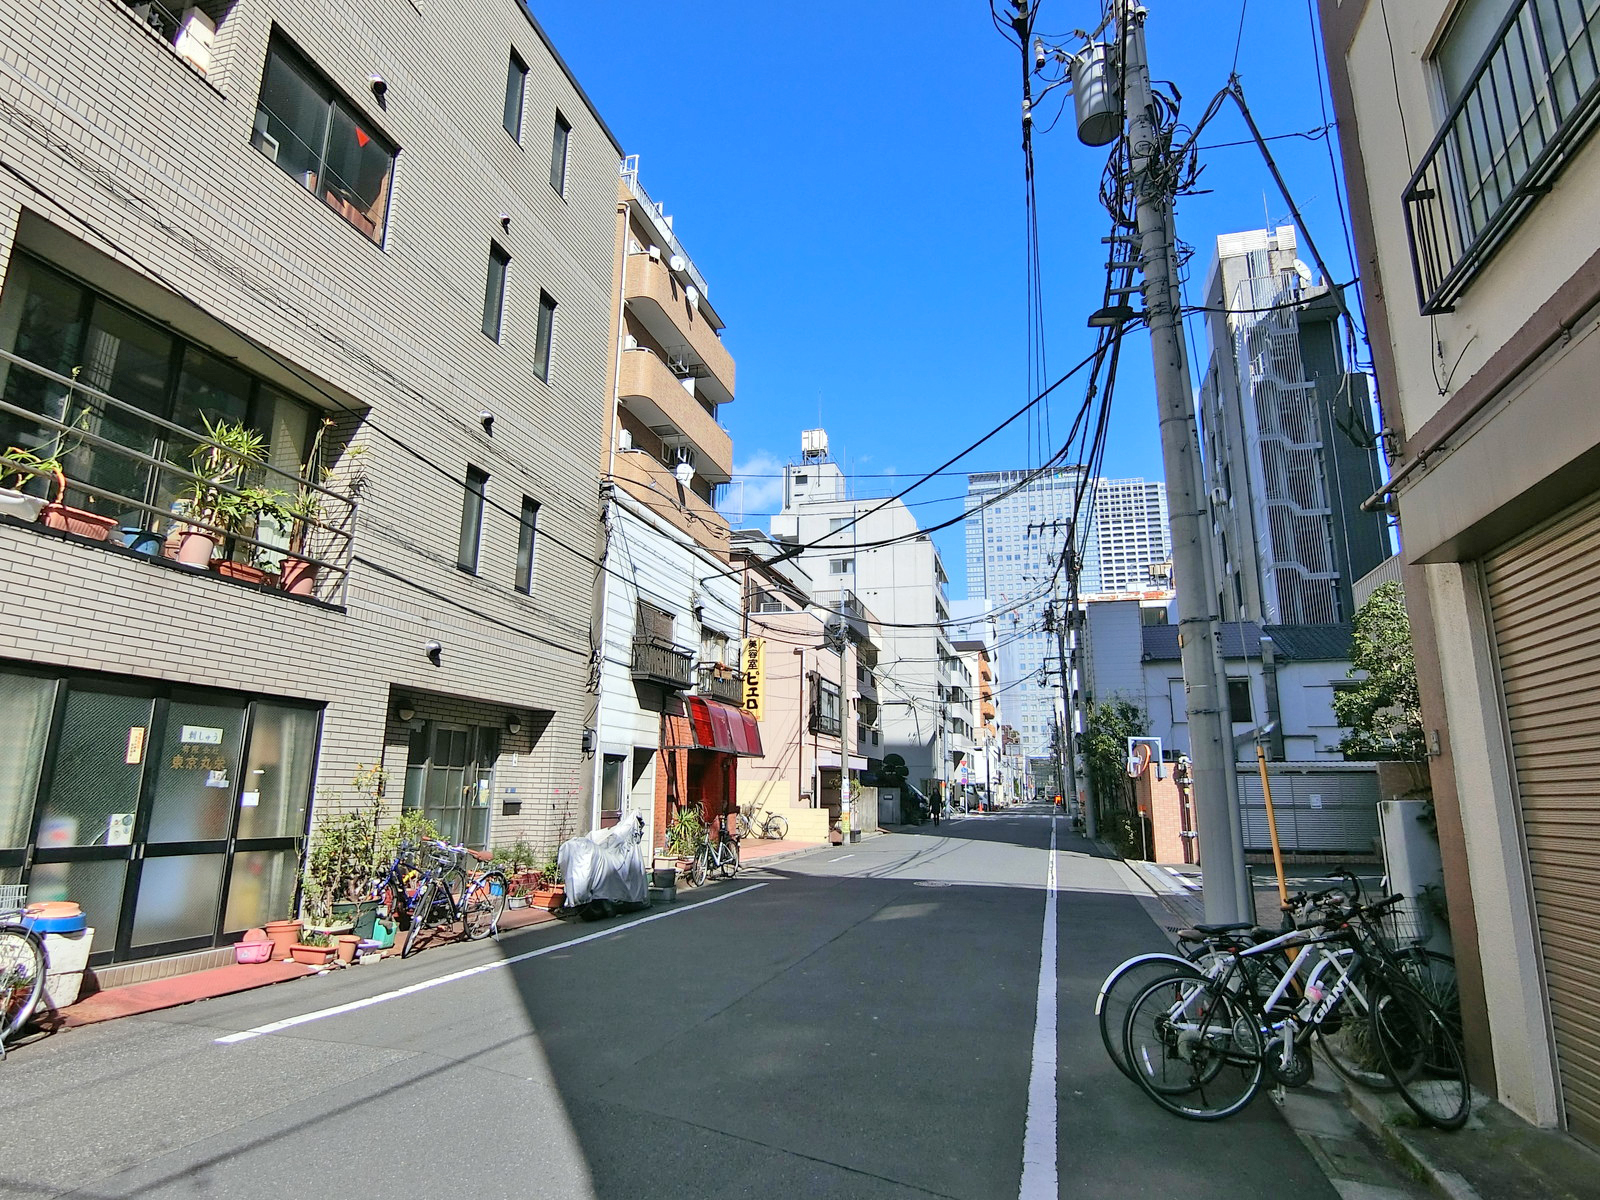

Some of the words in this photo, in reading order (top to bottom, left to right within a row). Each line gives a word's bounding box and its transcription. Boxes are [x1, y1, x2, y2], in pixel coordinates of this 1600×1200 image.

[746, 640, 760, 709] 美容室ピエロ
[188, 730, 218, 742] 刺しゅう
[1313, 971, 1349, 1024] GIANT
